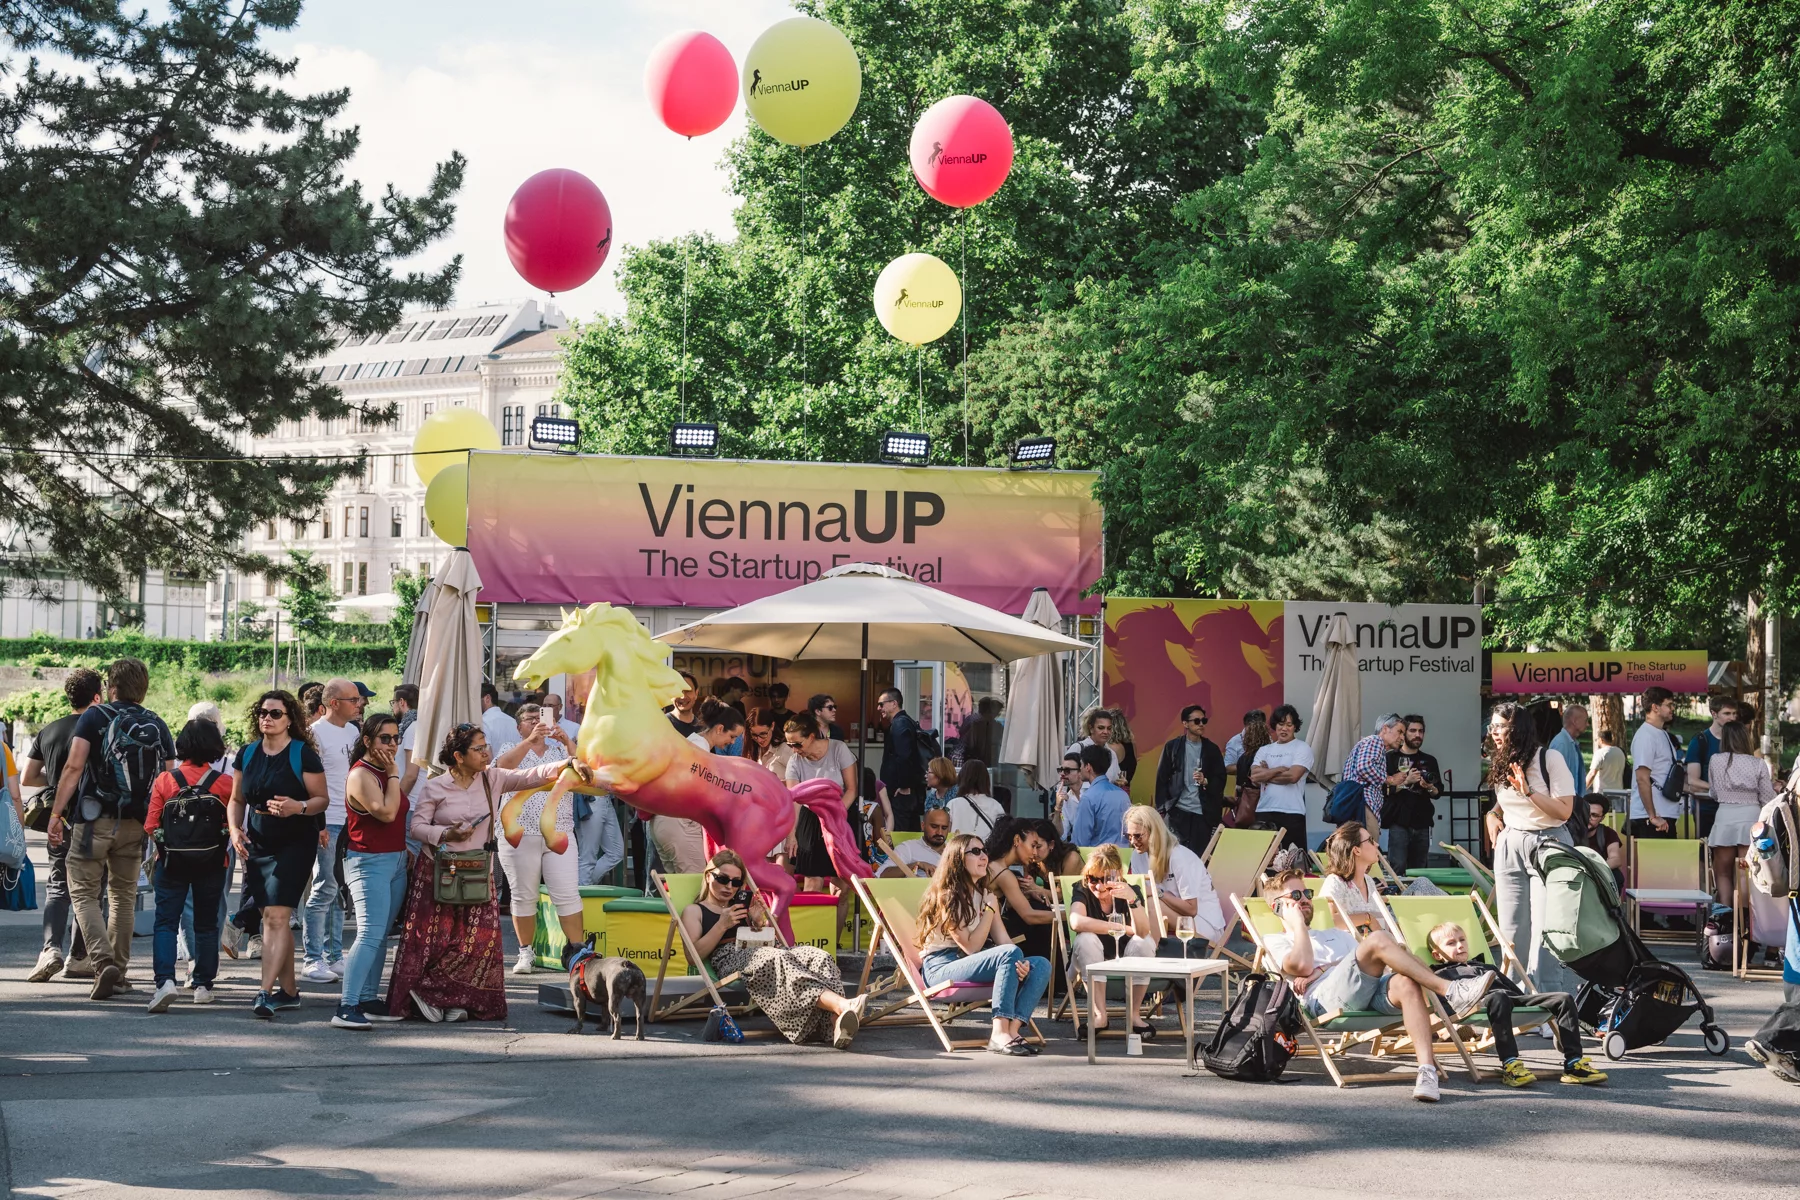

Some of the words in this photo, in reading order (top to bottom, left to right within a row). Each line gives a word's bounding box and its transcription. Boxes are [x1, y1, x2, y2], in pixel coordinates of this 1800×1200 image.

[757, 79, 810, 96] ViennaUP
[937, 153, 988, 165] ViennaUP
[903, 300, 944, 308] ViennaUP
[638, 482, 946, 544] ViennaUP
[639, 548, 699, 578] The
[707, 550, 822, 585] Startup
[832, 553, 942, 583] Ftival
[1297, 614, 1476, 650] VnnaUP
[1299, 654, 1325, 672] Th
[1358, 656, 1405, 676] artup
[1409, 655, 1474, 673] Festival
[1512, 661, 1623, 683] ViennaUP
[1626, 661, 1646, 671] The
[1649, 661, 1687, 672] Startup
[1626, 672, 1665, 682] Festival
[690, 762, 753, 795] #ViennaUP
